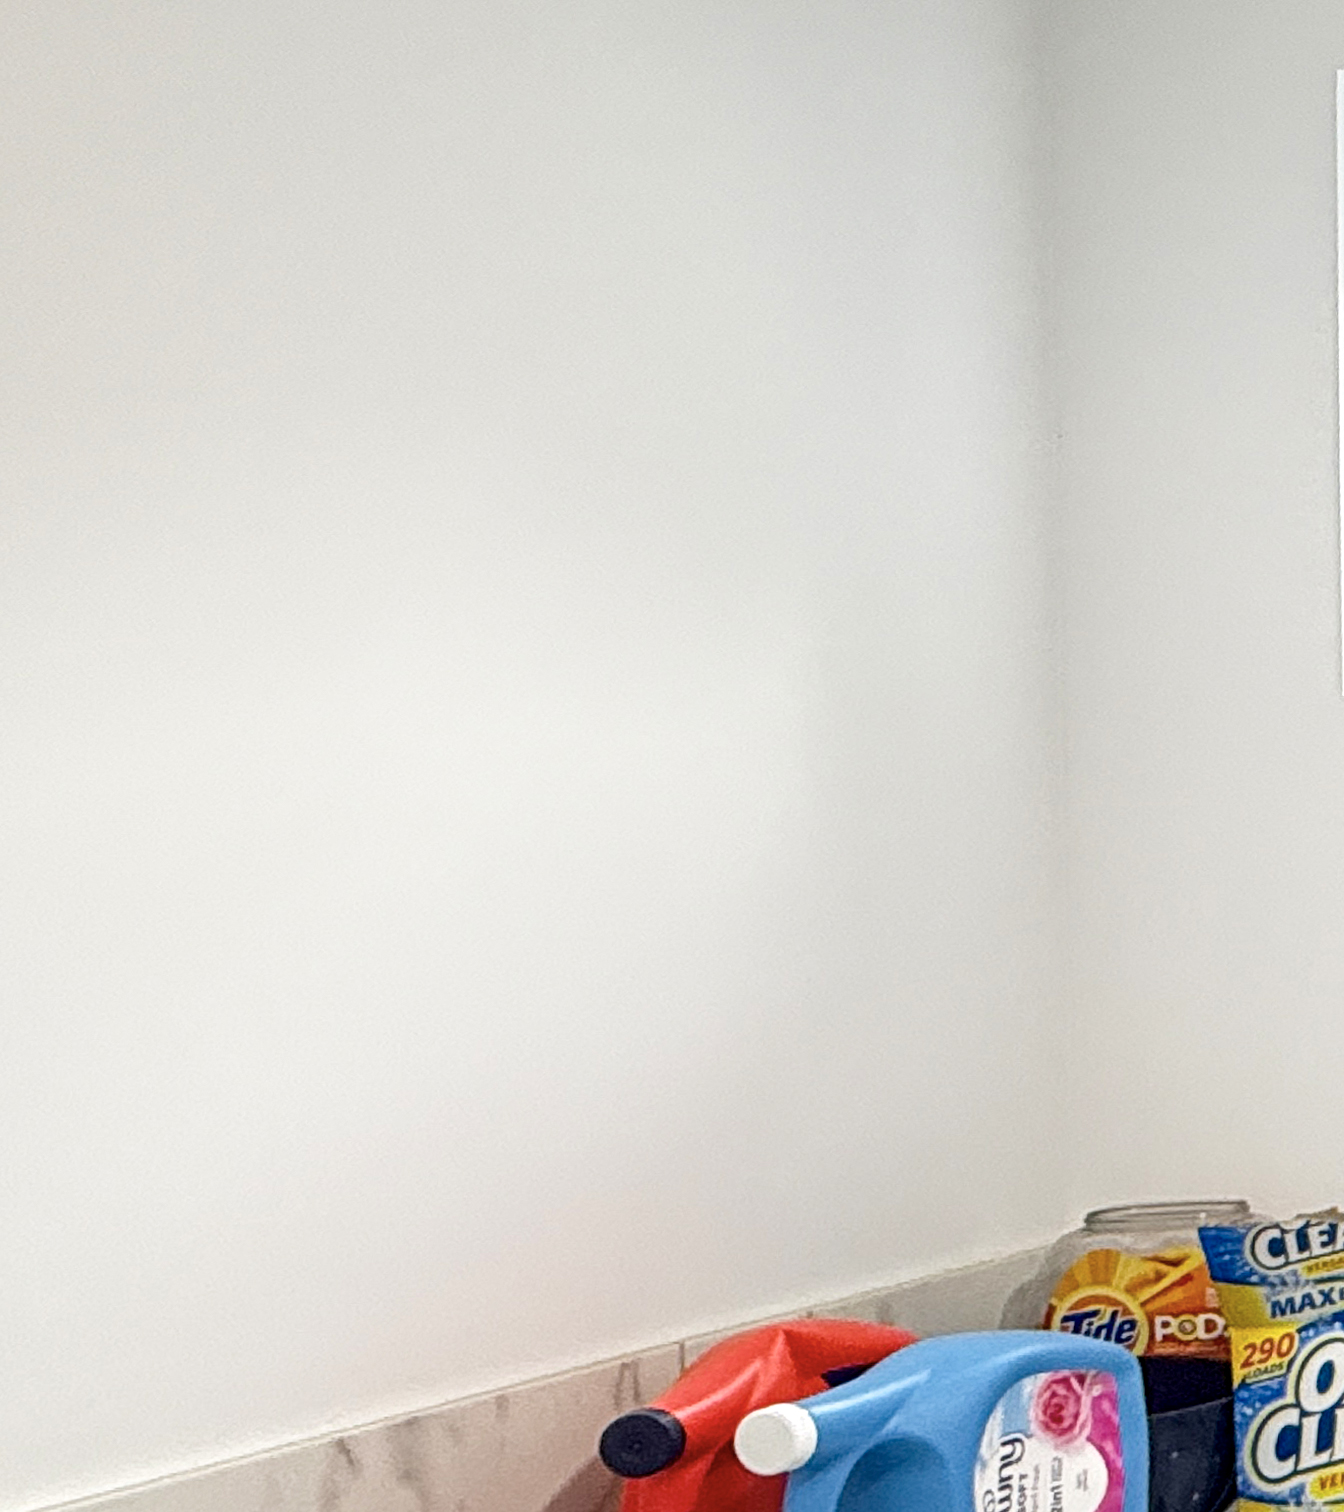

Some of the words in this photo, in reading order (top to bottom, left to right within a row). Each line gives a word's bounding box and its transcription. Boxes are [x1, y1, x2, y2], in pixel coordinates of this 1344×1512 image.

[1270, 1286, 1336, 1318] MAX
[1061, 1308, 1138, 1344] Tide
[1154, 1313, 1229, 1342] POD
[1239, 1332, 1296, 1370] 290
[1244, 1361, 1285, 1382] LOADS
